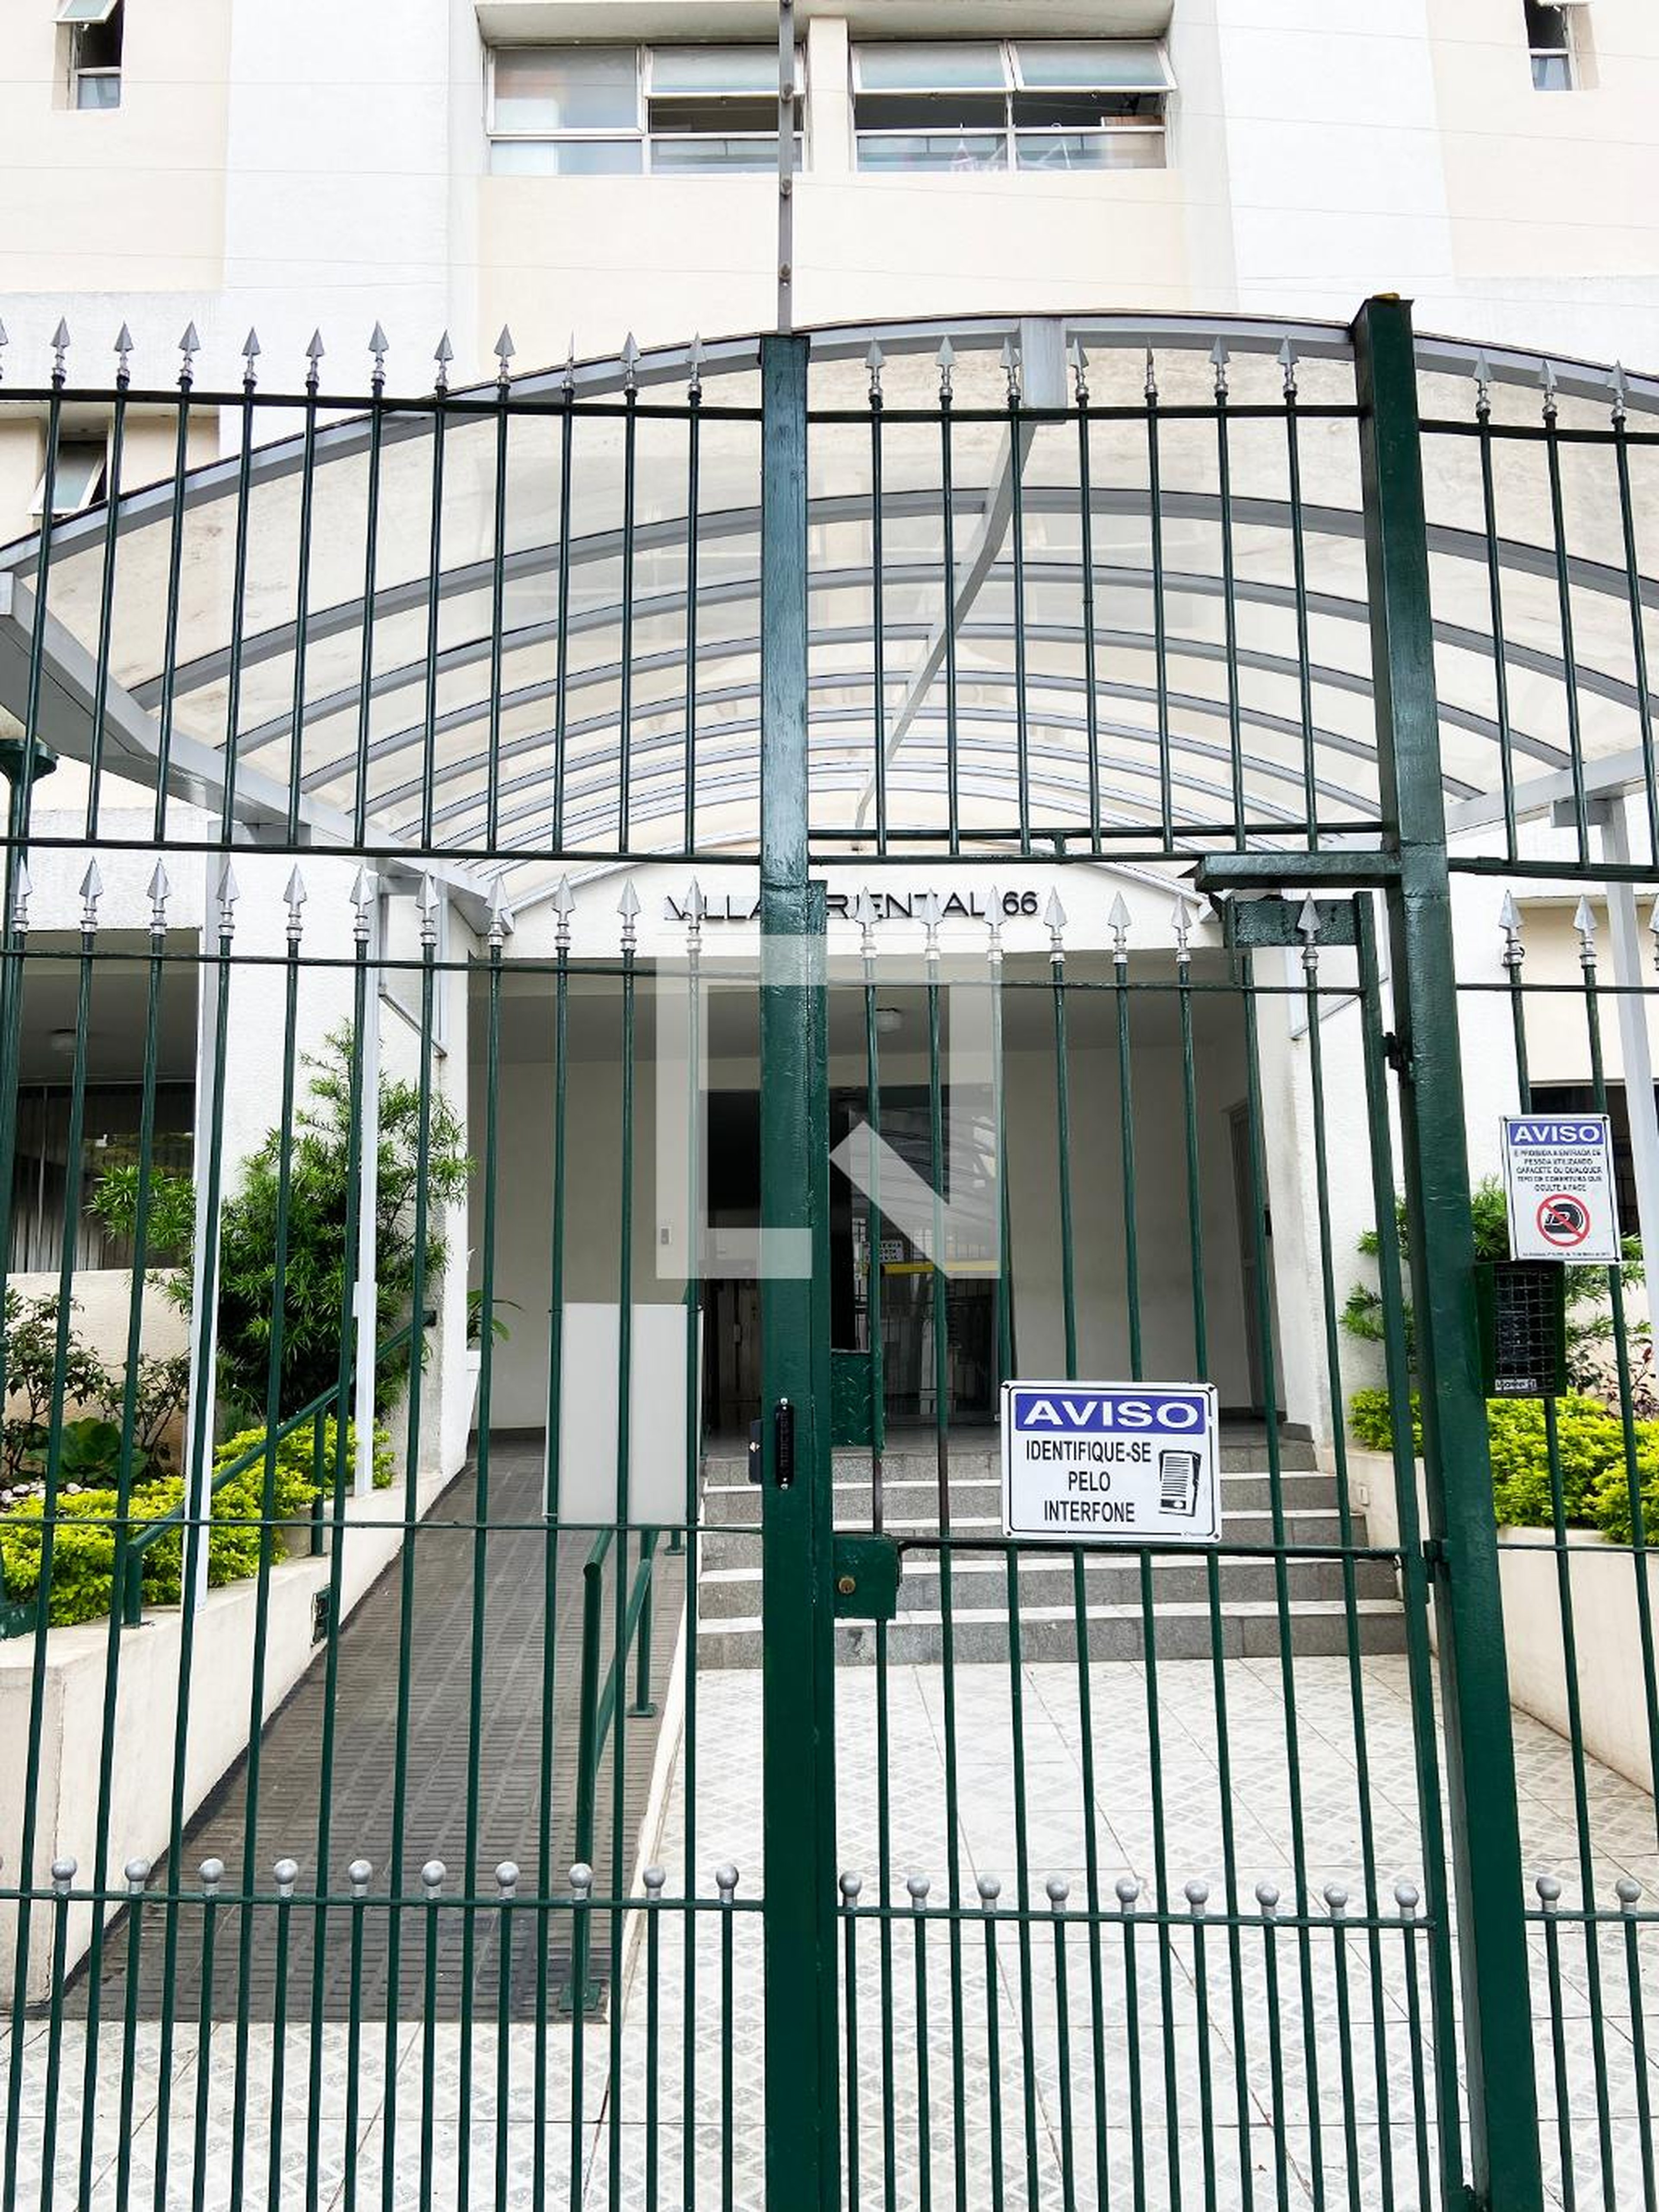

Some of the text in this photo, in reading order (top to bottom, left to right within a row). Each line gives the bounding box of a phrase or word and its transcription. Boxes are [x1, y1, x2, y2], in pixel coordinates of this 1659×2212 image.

[826, 891, 985, 919] RIENTAL
[1002, 891, 1038, 916] 66
[1514, 1126, 1599, 1142] AVISO
[1023, 1400, 1198, 1429] AVISO
[1026, 1440, 1151, 1463] IDENTIFIQUE-SE
[1068, 1471, 1110, 1491] PELO
[1044, 1500, 1135, 1522] INTERFONE
